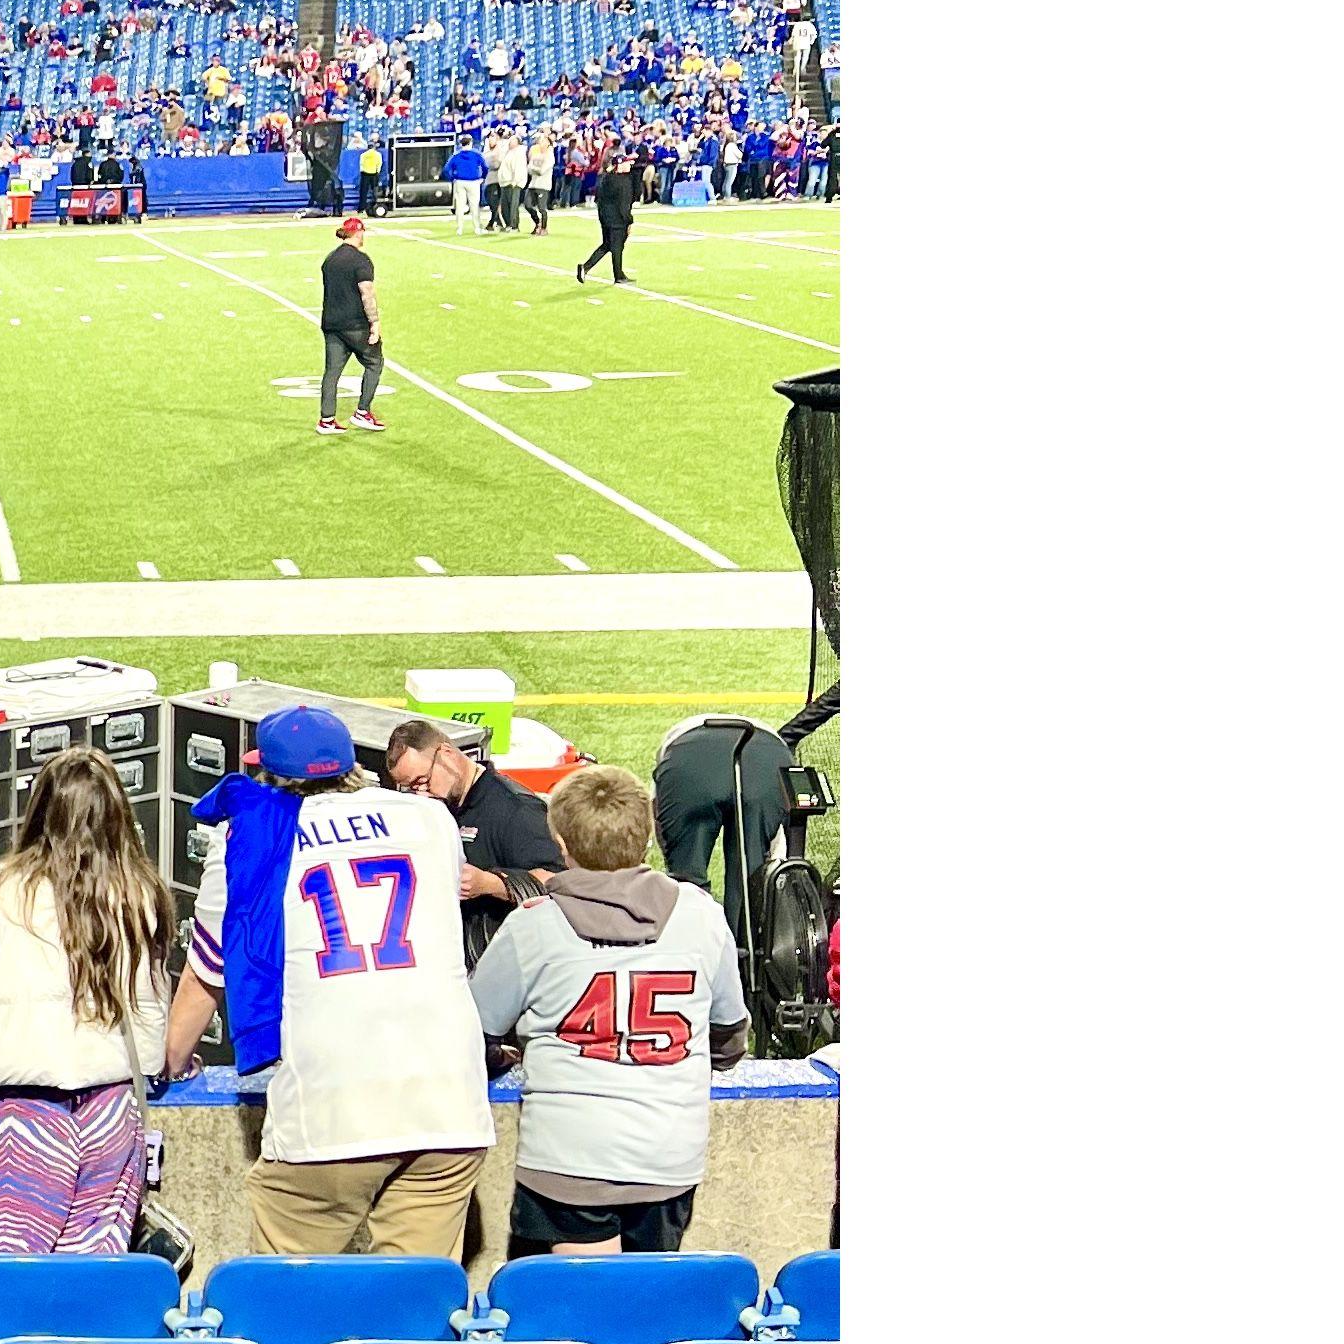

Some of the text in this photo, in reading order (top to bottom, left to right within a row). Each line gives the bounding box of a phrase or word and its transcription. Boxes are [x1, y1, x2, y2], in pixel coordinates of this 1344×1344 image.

[297, 812, 391, 852] ALLEN
[299, 854, 417, 979] 17
[555, 971, 697, 1066] 45
